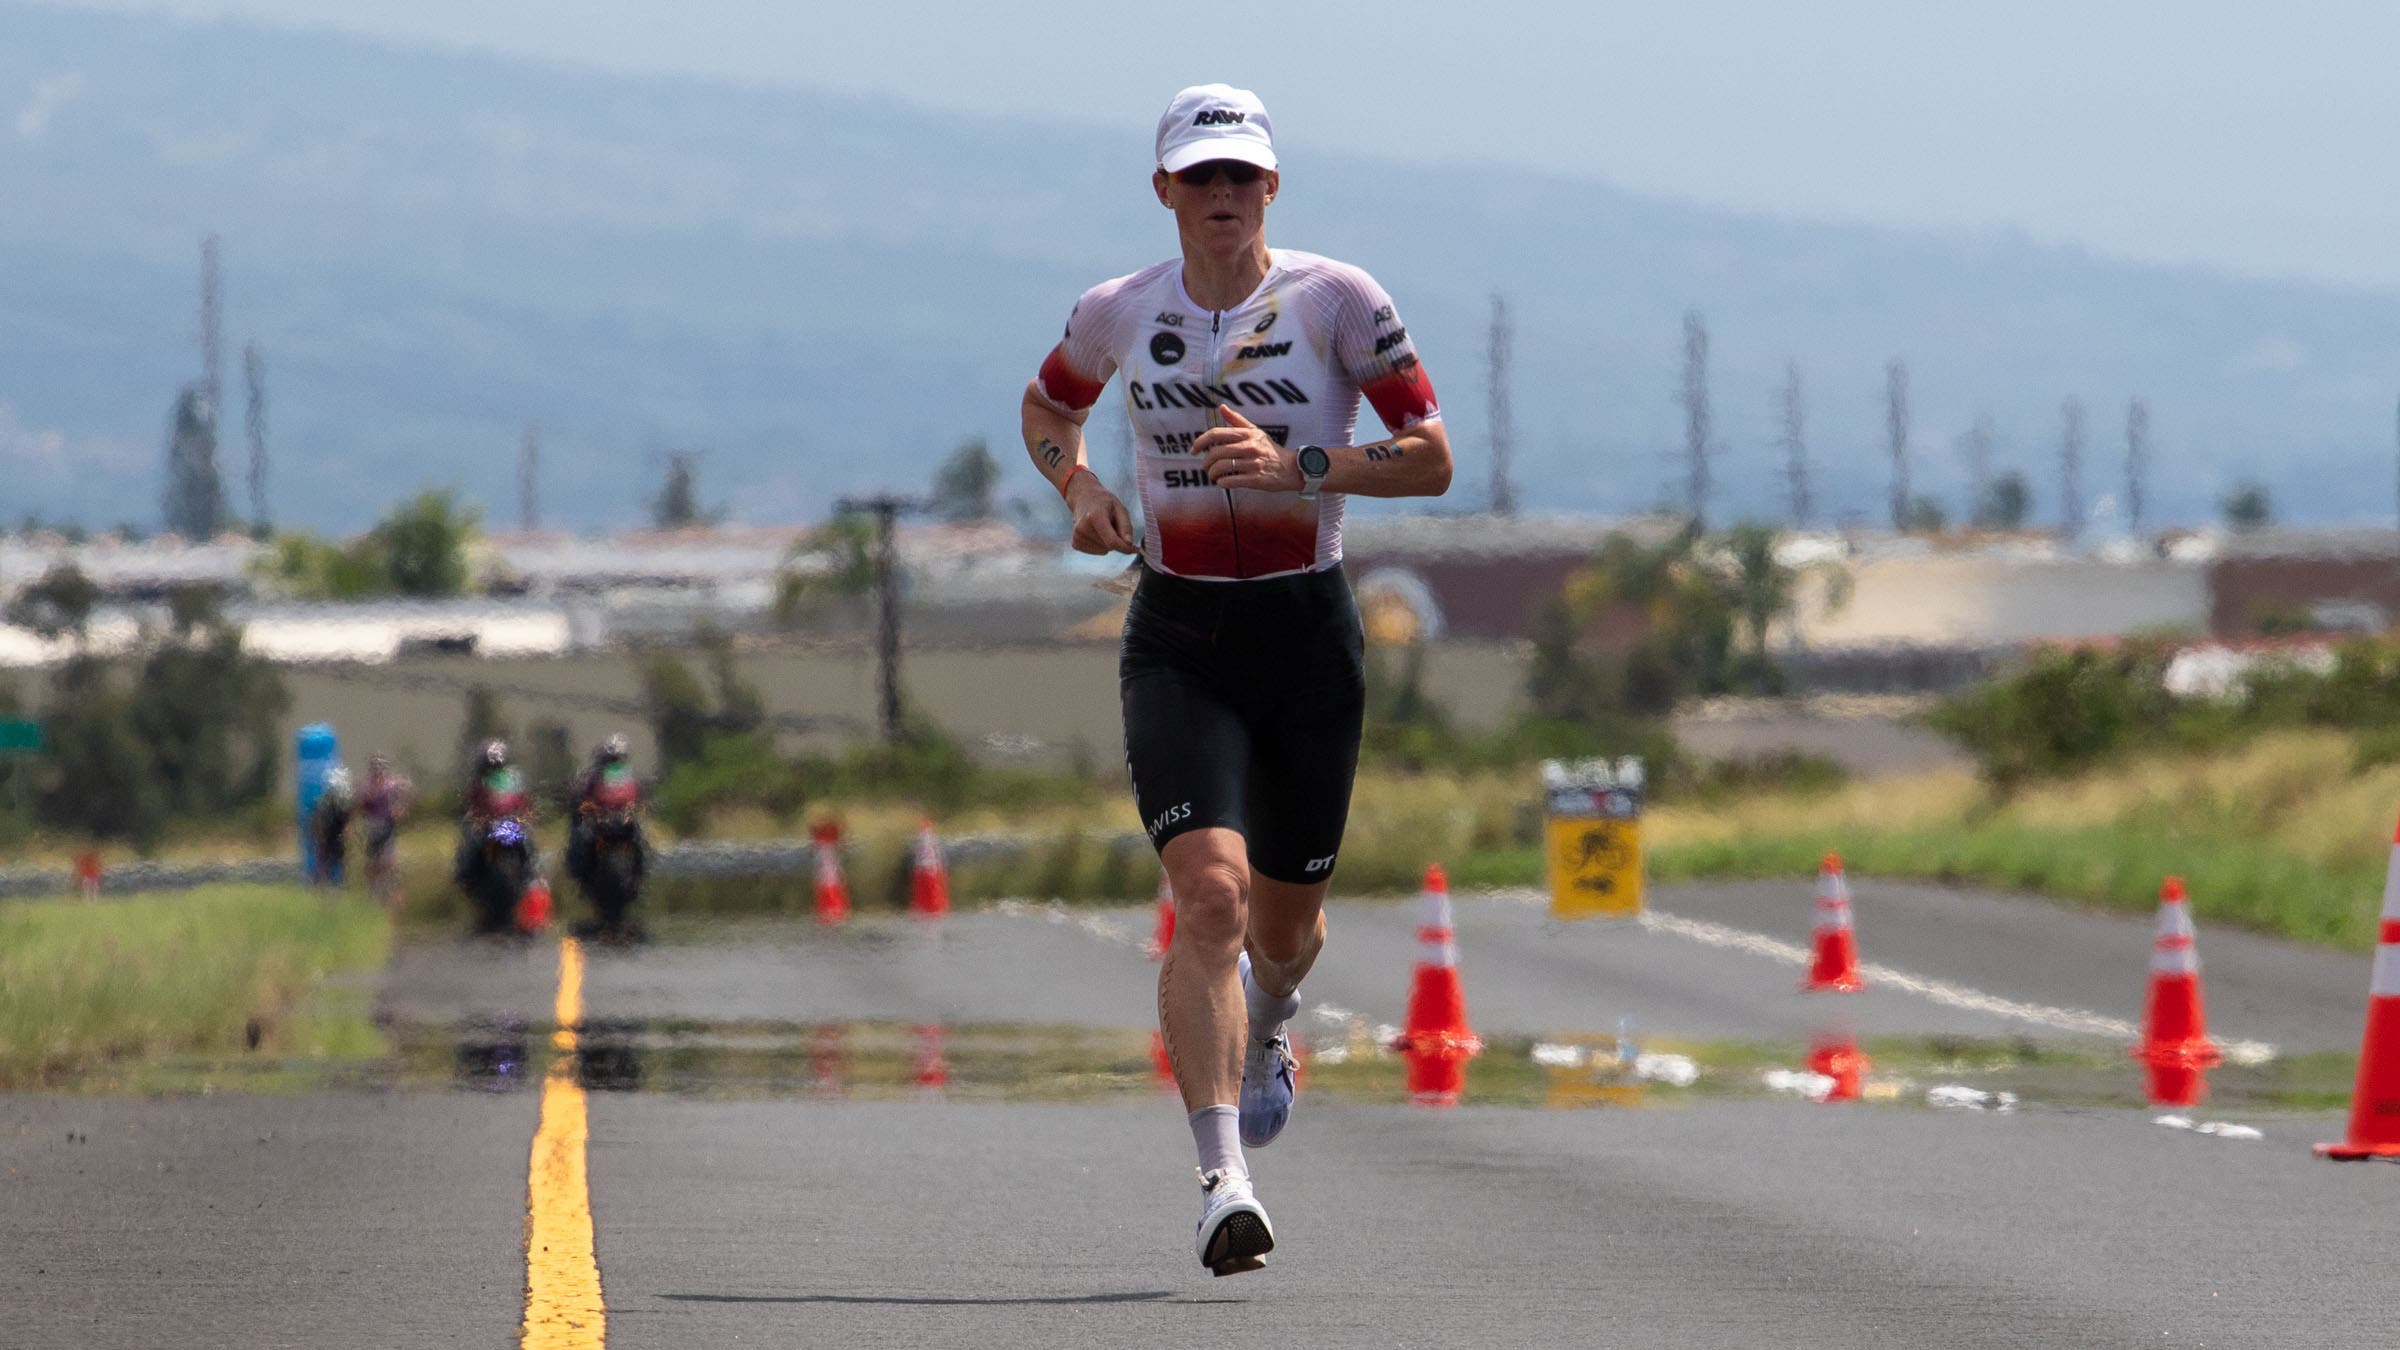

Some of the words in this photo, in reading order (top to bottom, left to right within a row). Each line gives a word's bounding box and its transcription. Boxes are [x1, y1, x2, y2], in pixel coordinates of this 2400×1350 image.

[1192, 110, 1246, 126] RAW
[1237, 340, 1293, 360] RAW
[1130, 378, 1310, 409] CANYON
[1304, 853, 1335, 871] DT
